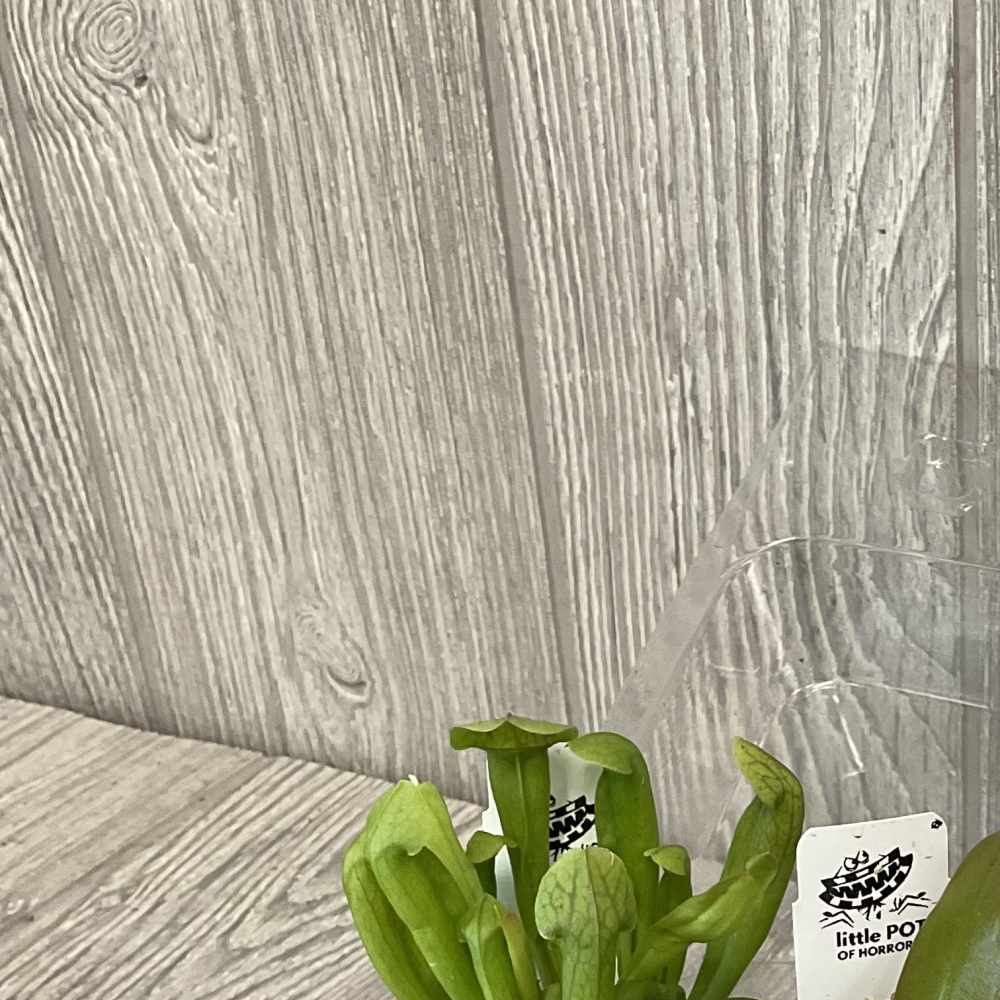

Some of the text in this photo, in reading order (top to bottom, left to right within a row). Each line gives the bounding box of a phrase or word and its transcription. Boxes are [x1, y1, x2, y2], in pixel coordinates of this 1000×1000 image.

[836, 927, 882, 948] little
[837, 940, 914, 962] OF HORROR
